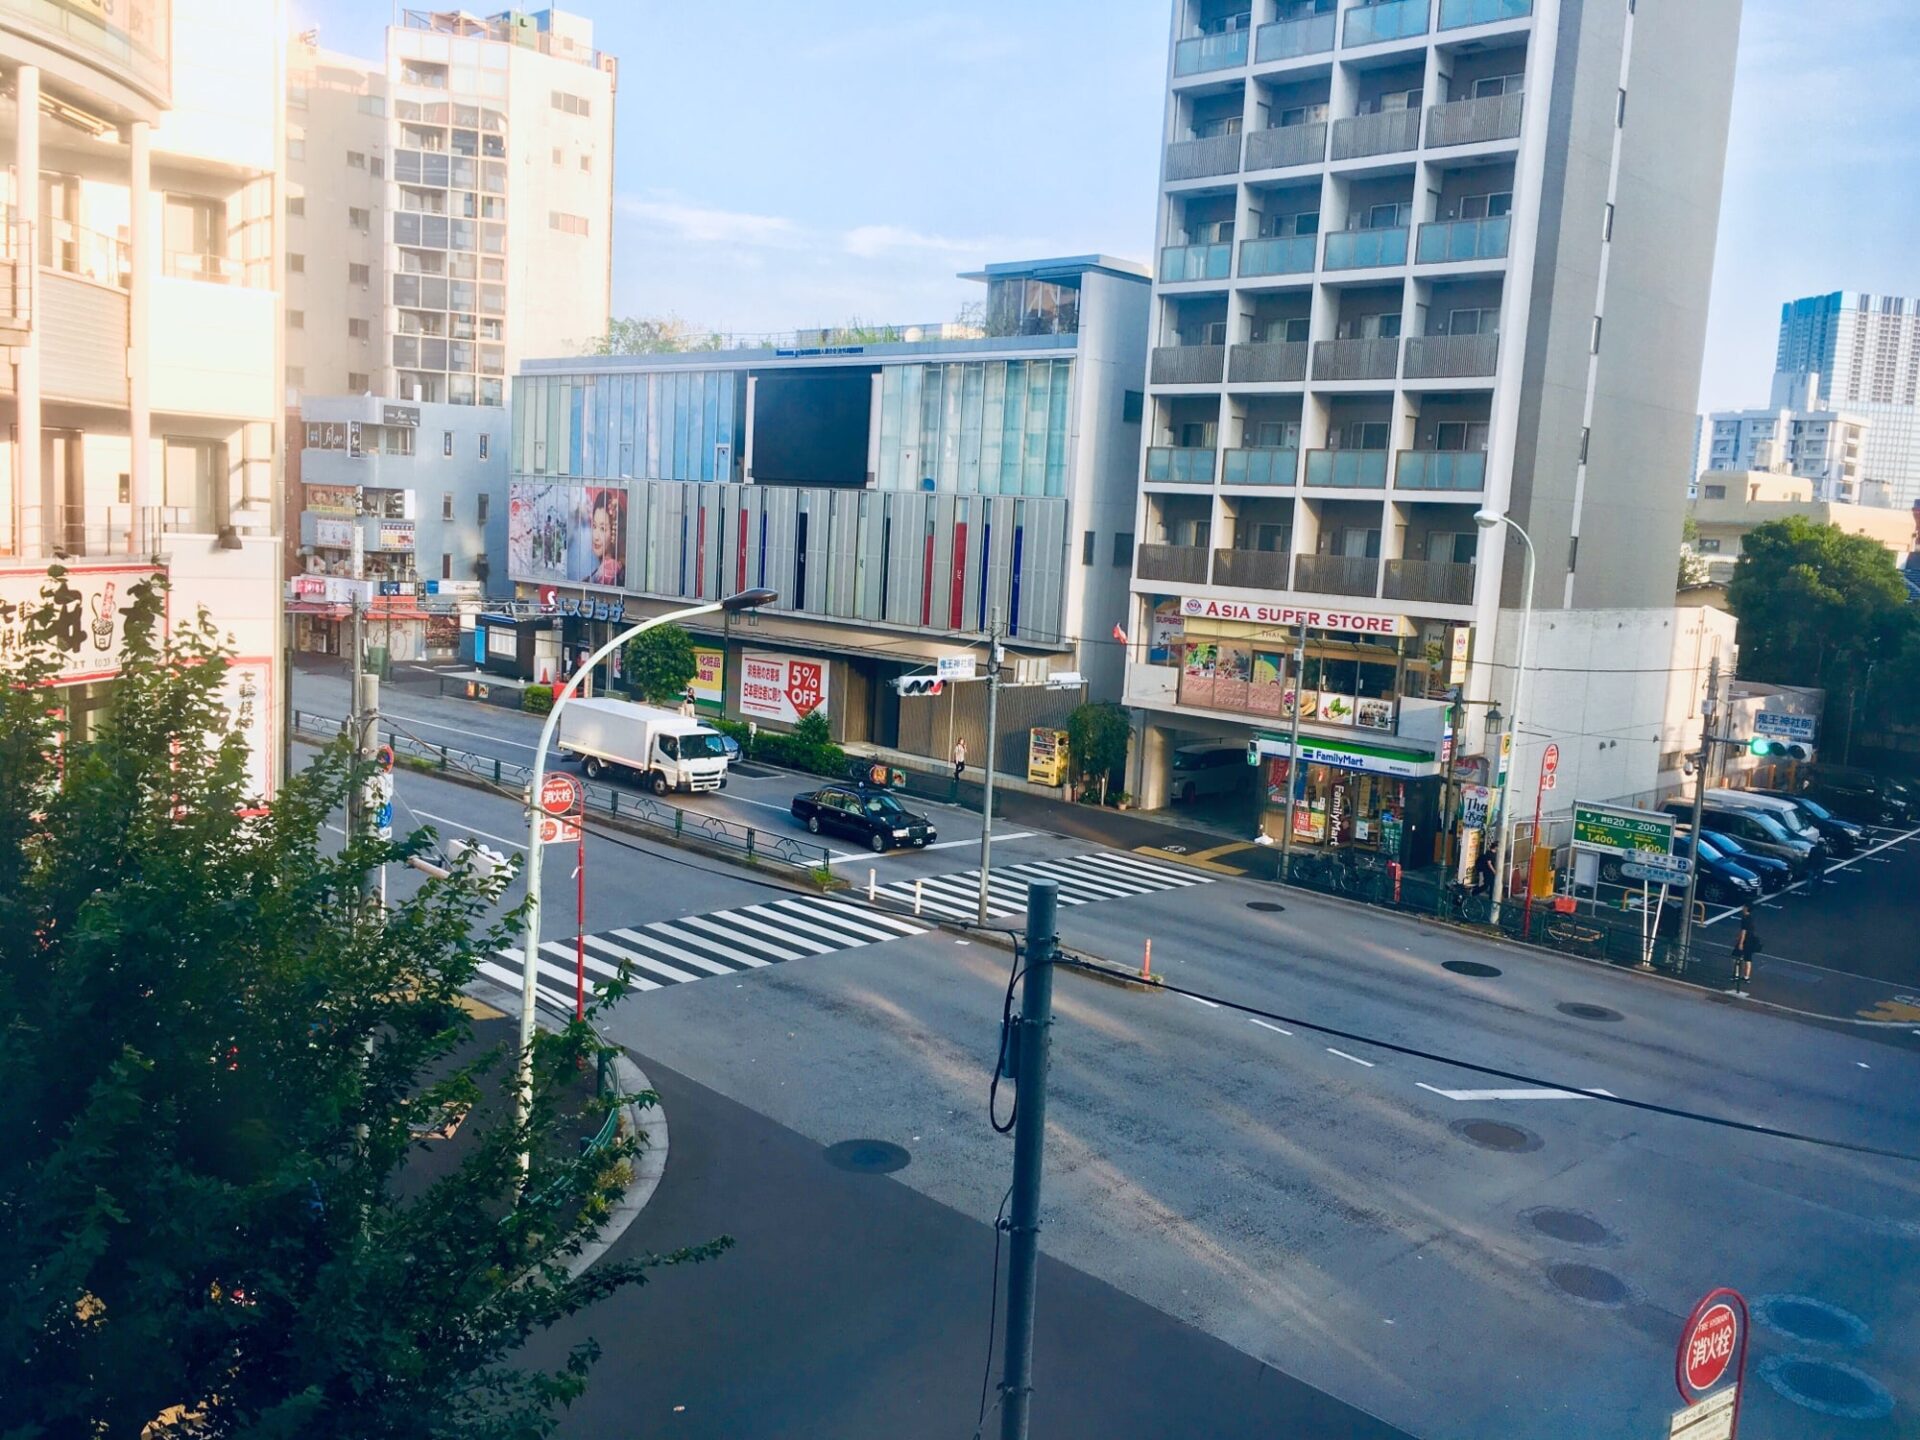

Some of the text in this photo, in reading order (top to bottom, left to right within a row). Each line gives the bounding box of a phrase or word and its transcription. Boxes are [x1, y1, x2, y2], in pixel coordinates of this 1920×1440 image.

[1206, 601, 1394, 634] ASIA SUPER STORE
[791, 665, 818, 689] 5%
[791, 690, 817, 707] OFF
[1757, 714, 1812, 730] 鬼王神社前
[1316, 751, 1364, 767] FamilyMart
[543, 788, 572, 804] 消火栓
[1330, 784, 1345, 847] FamilyMart
[1690, 1326, 1731, 1369] 消火栓
